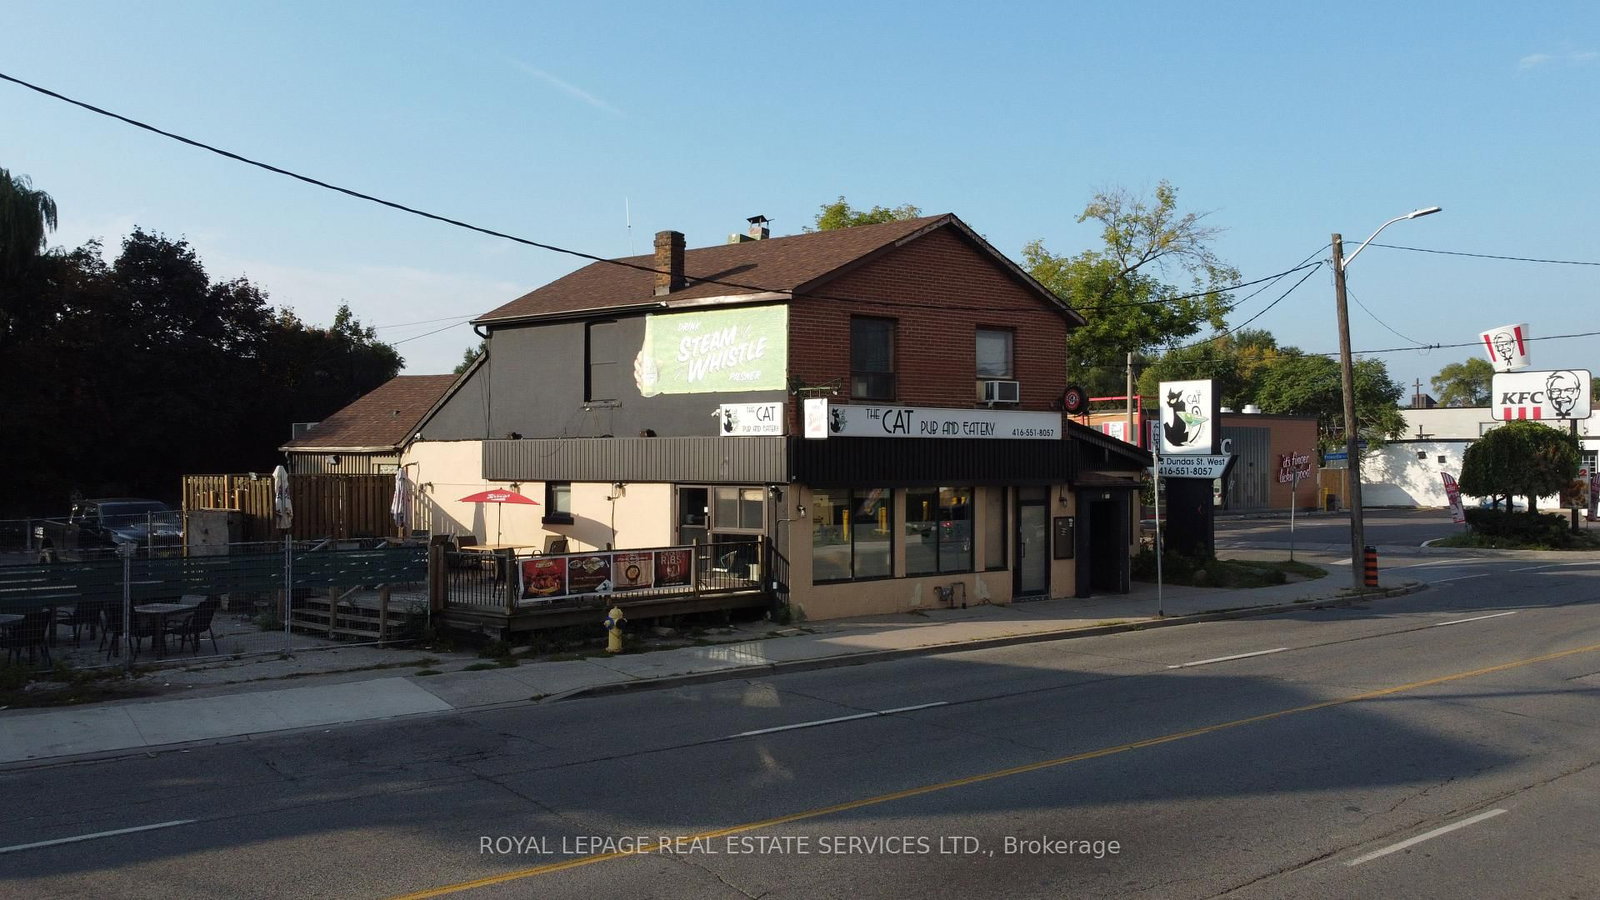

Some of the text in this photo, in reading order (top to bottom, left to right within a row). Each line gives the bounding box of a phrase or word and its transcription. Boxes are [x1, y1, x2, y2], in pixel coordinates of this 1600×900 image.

[677, 325, 737, 362] STEAM
[687, 337, 767, 383] WHISTLE
[1186, 393, 1201, 404] CAT
[1501, 392, 1543, 404] KFC
[756, 406, 776, 421] CAT
[865, 408, 1054, 437] THE CAT PUB AND EATERY 416-551-8057
[1166, 457, 1194, 465] Dundas
[1197, 457, 1205, 465] St.
[1207, 457, 1225, 465] West
[1159, 467, 1213, 476] 416-551-8057
[661, 555, 682, 565] RIBS
